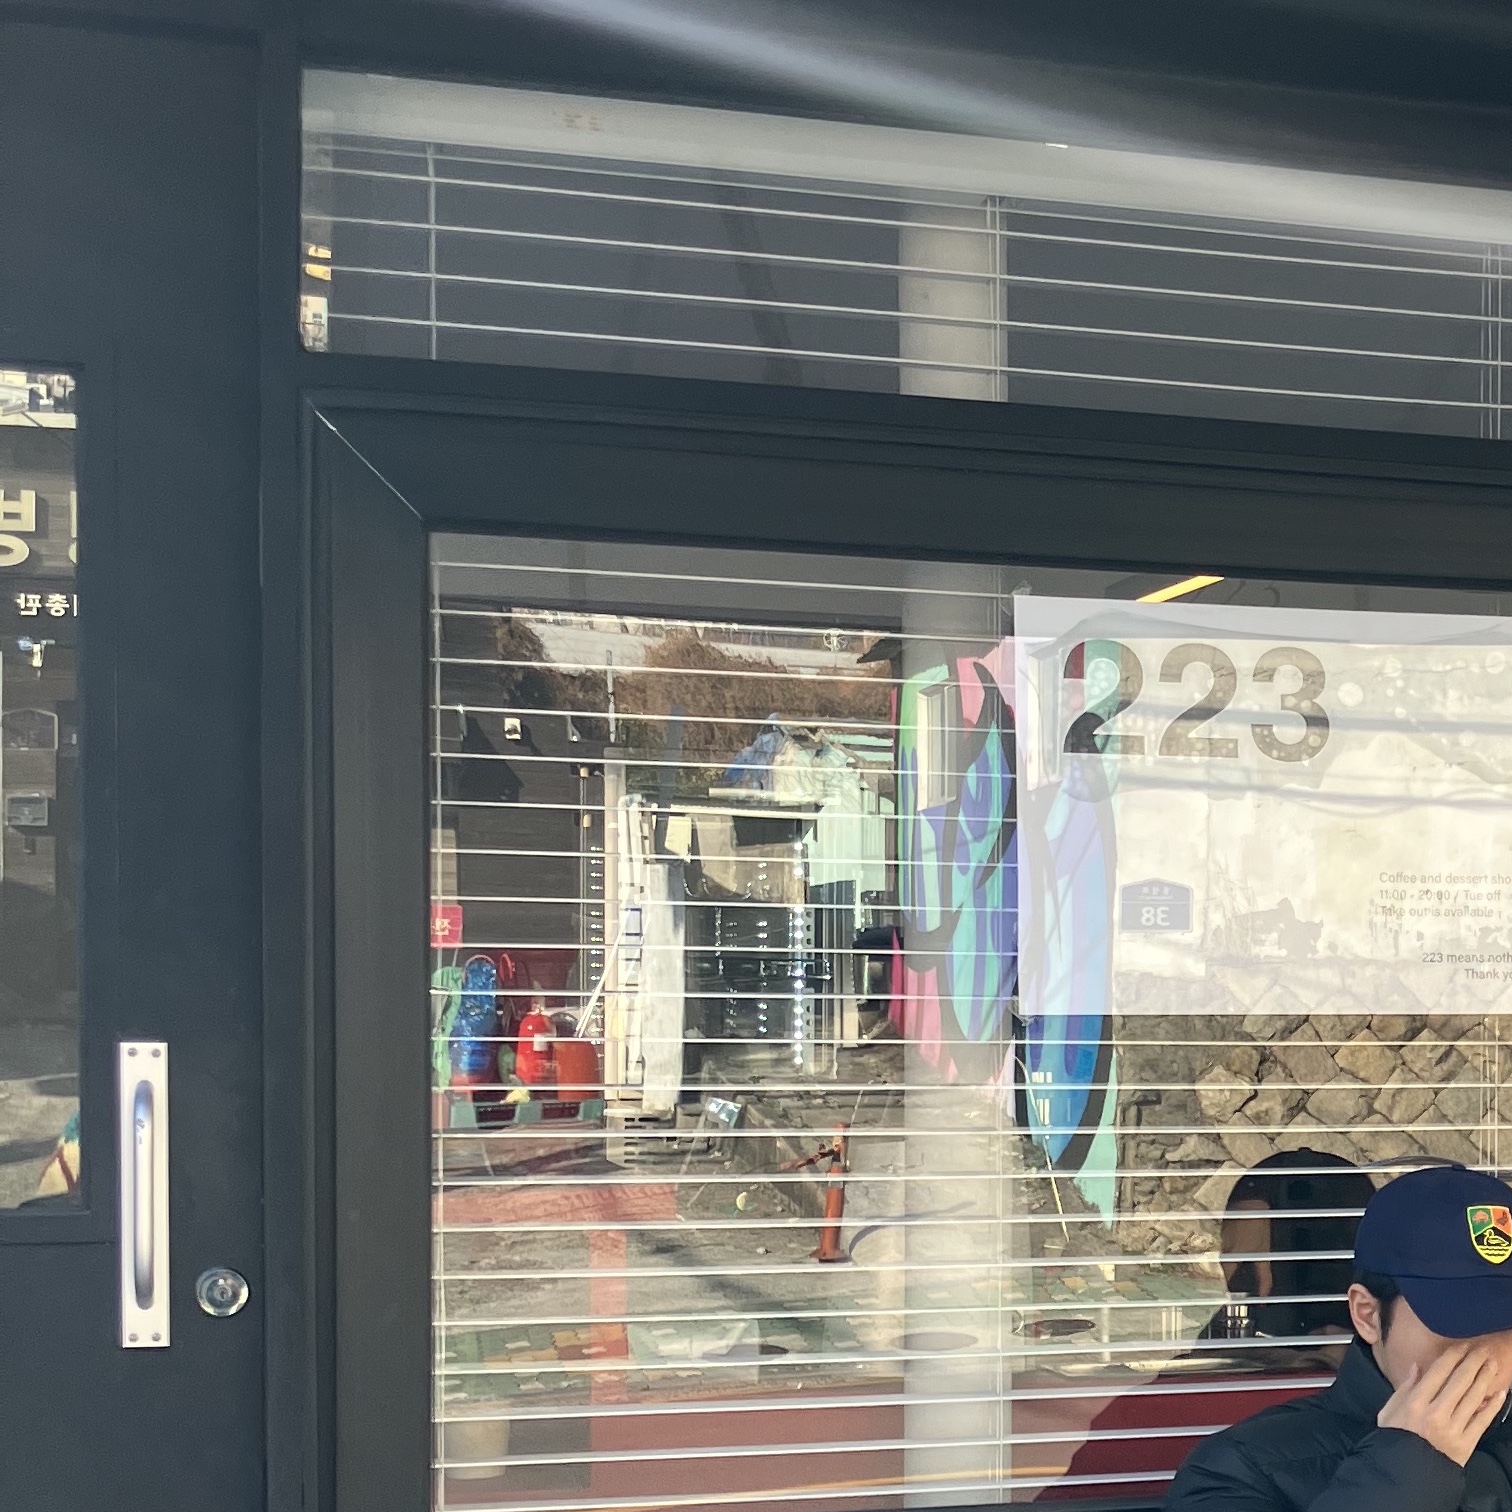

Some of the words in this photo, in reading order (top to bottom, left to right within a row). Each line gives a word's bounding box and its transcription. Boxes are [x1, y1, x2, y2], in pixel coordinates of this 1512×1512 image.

[1063, 638, 1330, 763] 223
[1379, 871, 1417, 884] Coffee
[1420, 872, 1442, 884] and
[1445, 872, 1489, 885] dessert
[1379, 889, 1407, 901] 11:00
[1463, 889, 1484, 901] Tue
[1486, 889, 1502, 902] off
[1443, 905, 1495, 918] available
[1421, 952, 1444, 964] 223
[1446, 953, 1485, 964] means
[1464, 967, 1501, 980] Thank
